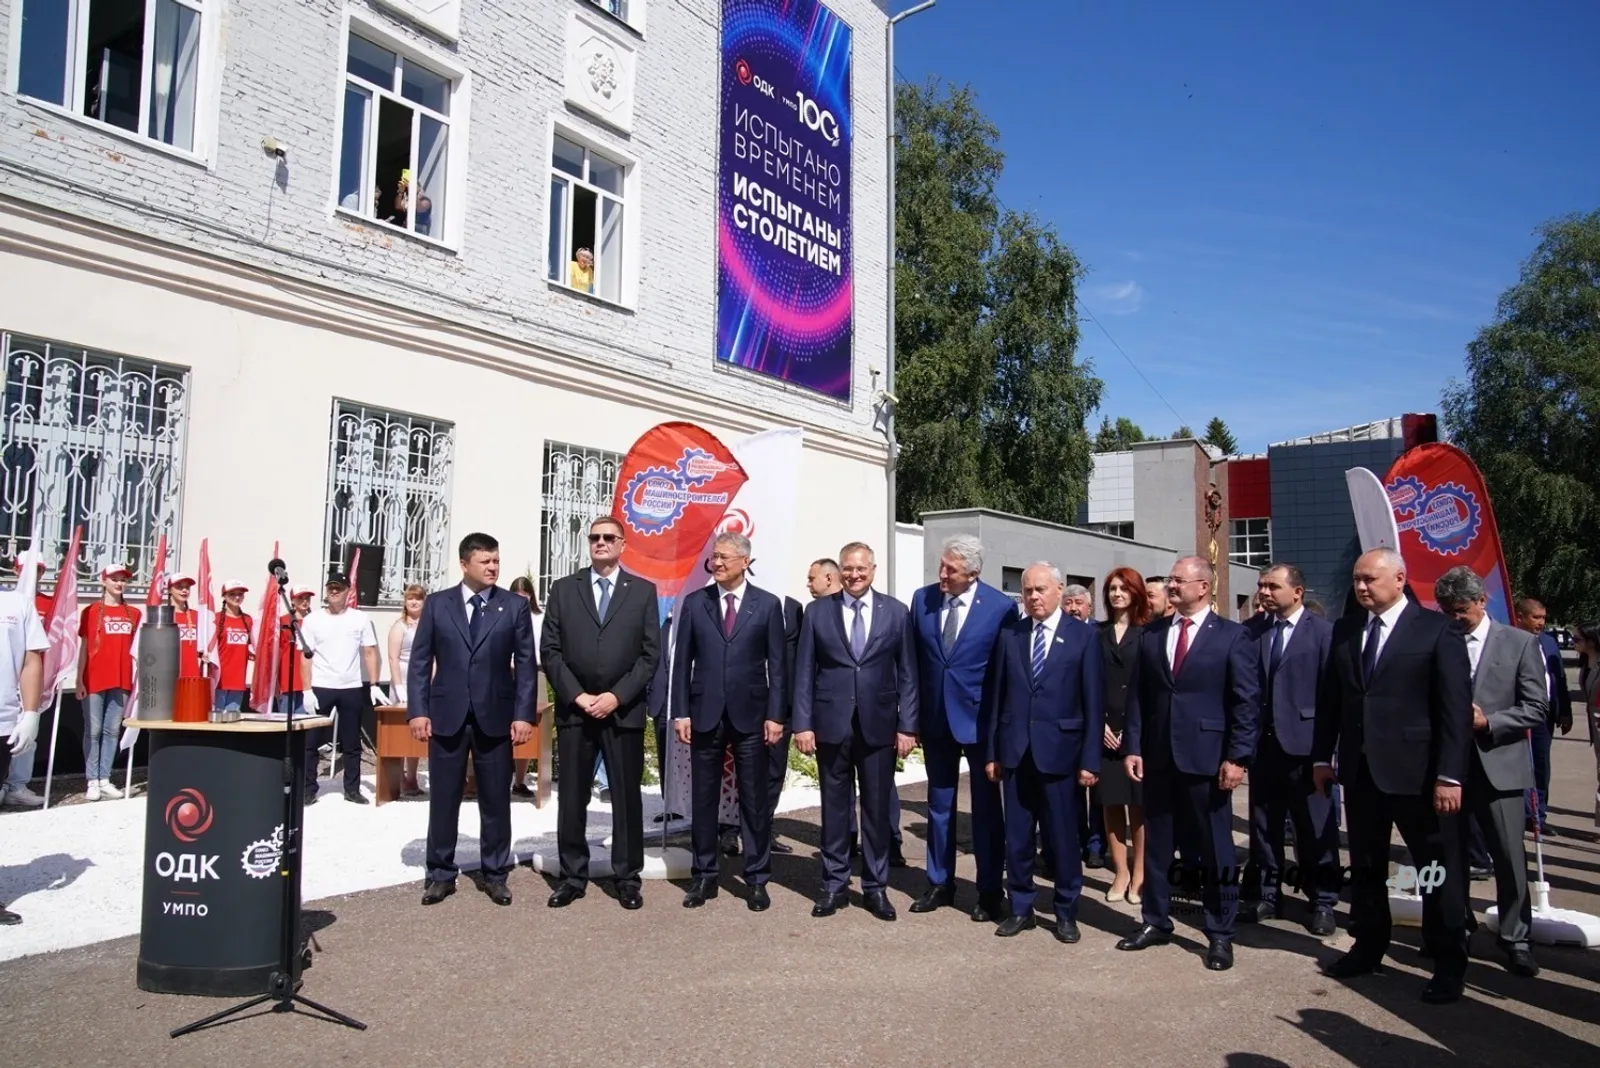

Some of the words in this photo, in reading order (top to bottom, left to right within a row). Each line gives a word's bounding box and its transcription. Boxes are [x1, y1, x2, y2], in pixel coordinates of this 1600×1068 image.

[753, 75, 775, 99] ОДК
[735, 103, 841, 187] ИСПЫТАНО
[735, 132, 841, 215] ВРЕМЕНЕМ
[734, 172, 841, 250] ИСПЫТАНЫ
[733, 203, 841, 276] СТОЛЕТИЕМ
[644, 488, 726, 503] МАШИНОСТРОИТЕЛЕЙ
[647, 480, 669, 489] СОЮЗ
[642, 499, 672, 509] РОССИИ
[155, 852, 220, 882] ОДК
[163, 902, 208, 916] УМПО
